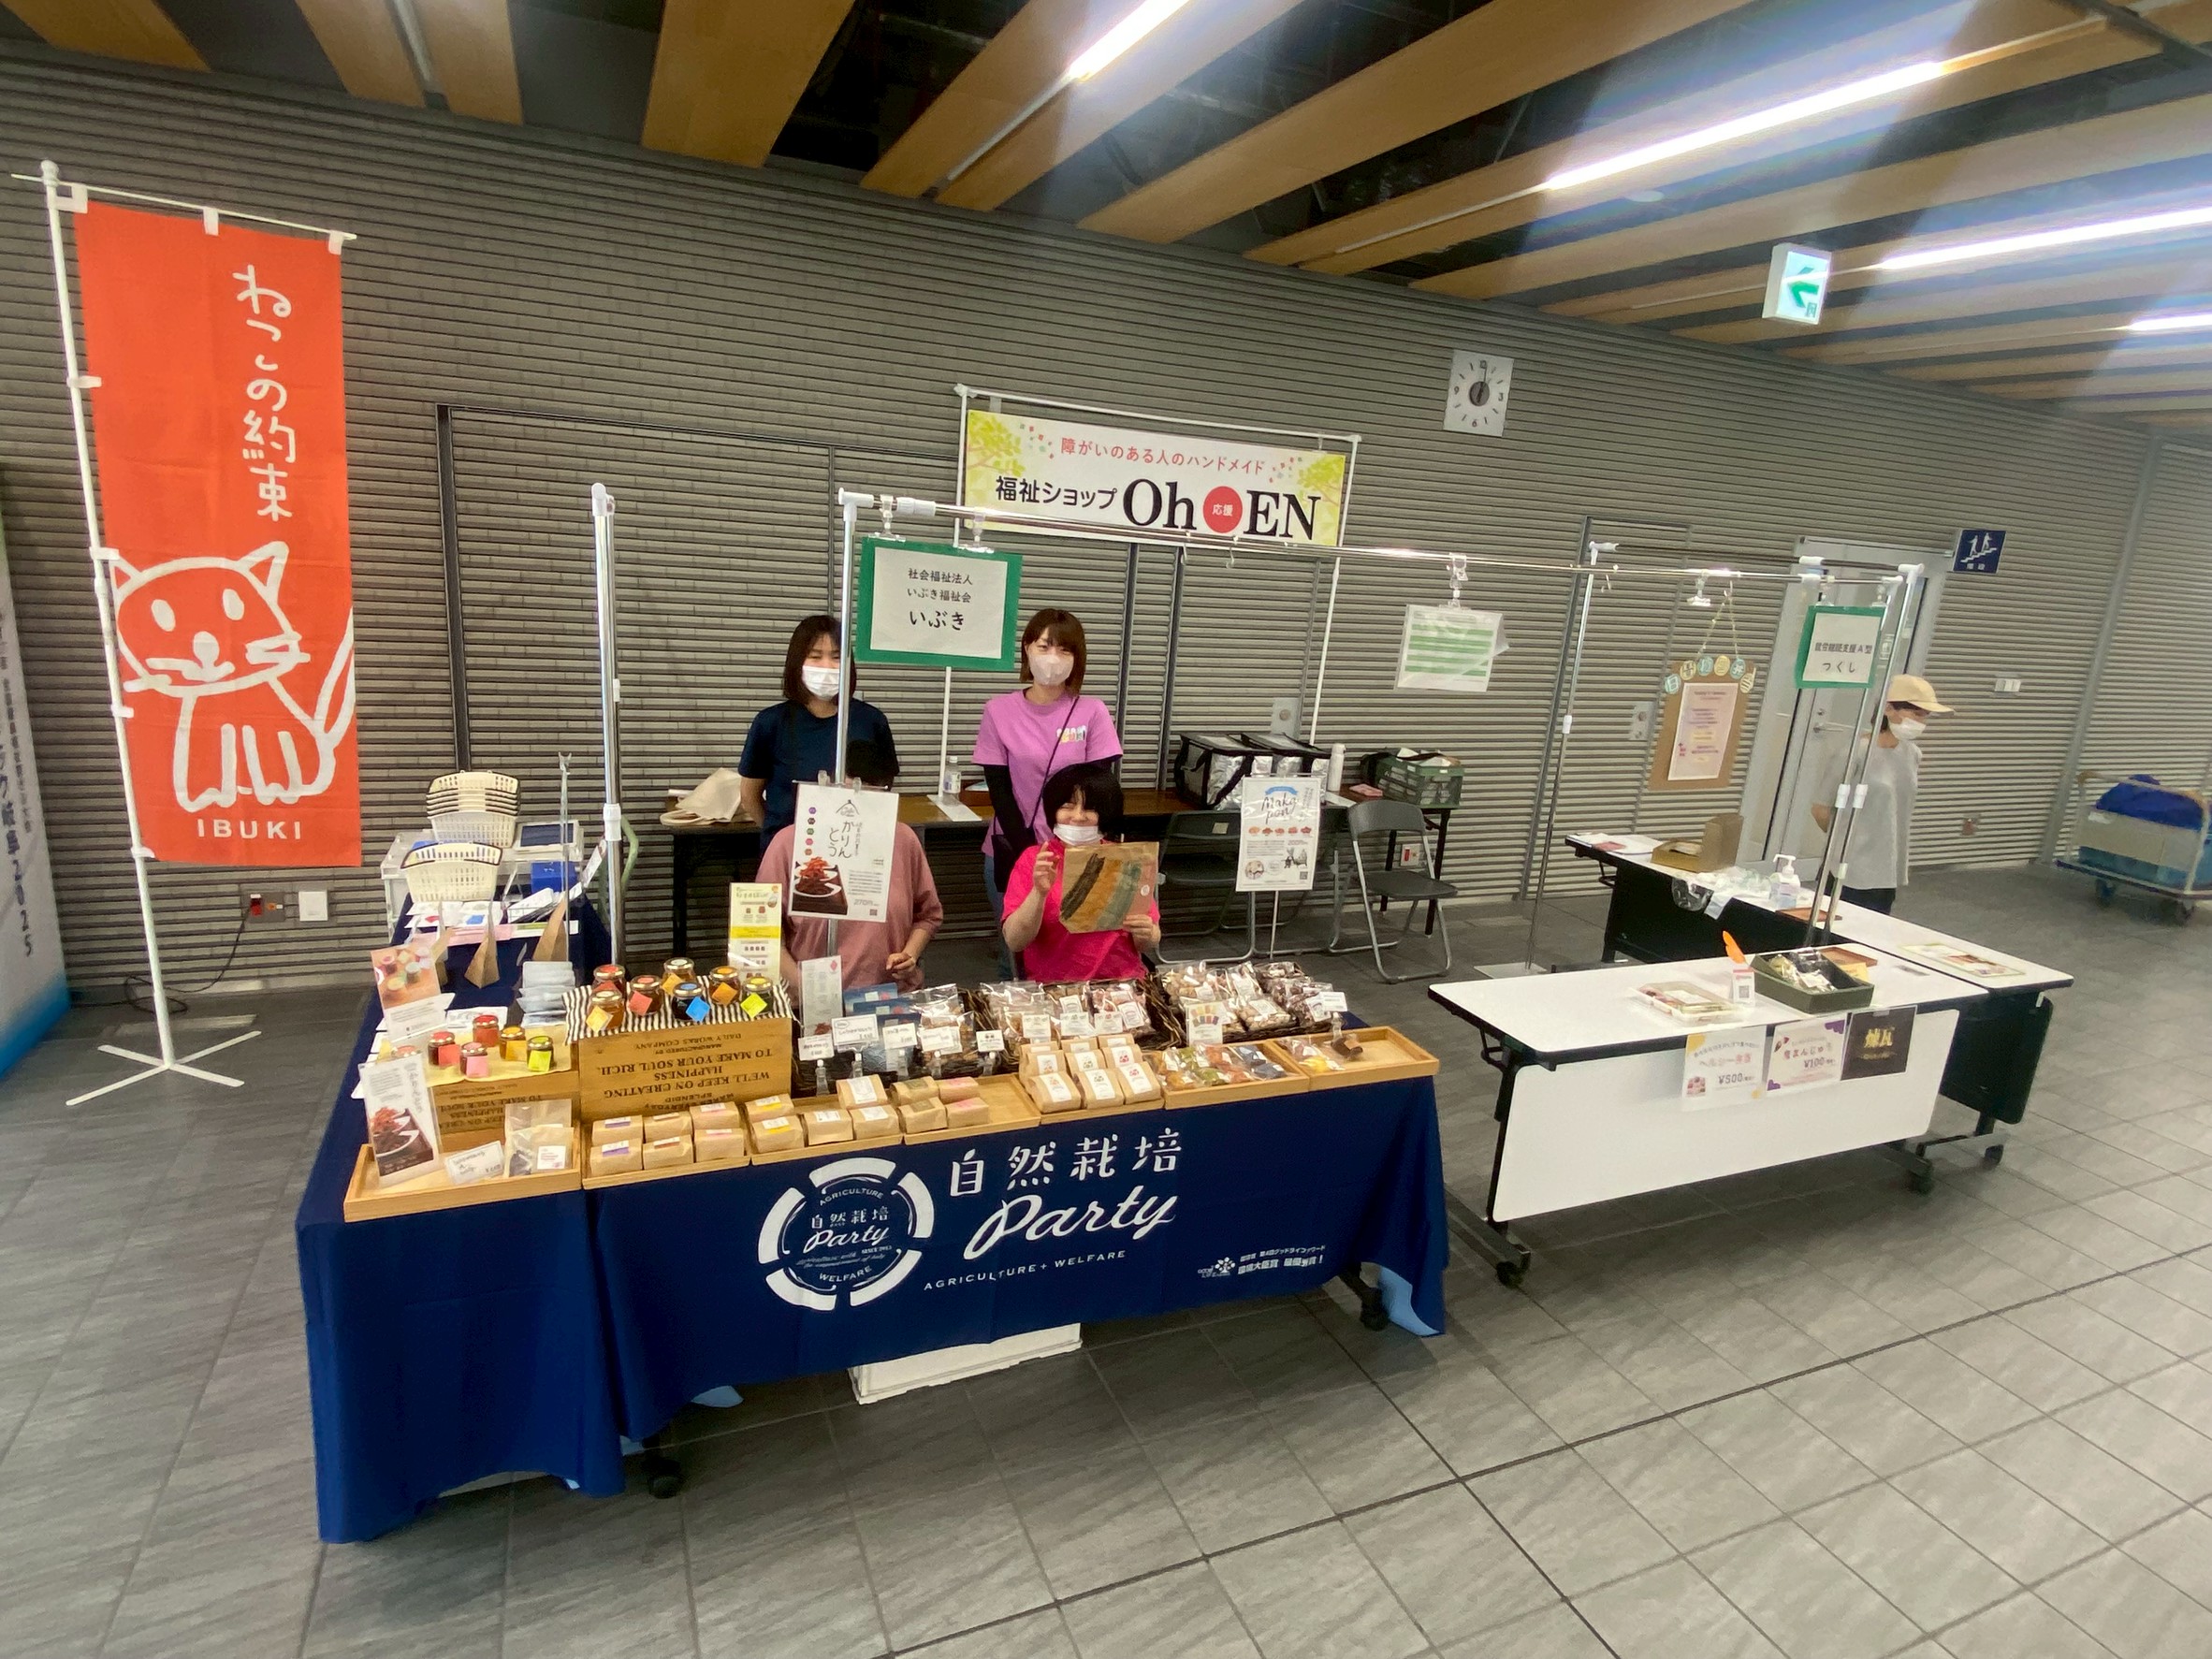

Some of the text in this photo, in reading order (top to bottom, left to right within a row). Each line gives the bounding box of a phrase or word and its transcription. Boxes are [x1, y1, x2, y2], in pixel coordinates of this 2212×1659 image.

[232, 264, 296, 522] ねこの約束
[1060, 436, 1265, 475] 障がいのある人のハンドメイド
[995, 474, 1118, 510] 福祉ショップ
[1123, 478, 1198, 531] Oh
[1243, 489, 1321, 541] EN
[908, 567, 973, 586] 社会福祉法人
[907, 588, 972, 604] いぶき福祉会
[910, 610, 965, 631] いぶき
[1822, 661, 1856, 674] つくし
[196, 817, 303, 841] IBUKI
[677, 1054, 713, 1066] YOUR
[717, 1051, 752, 1061] MAKE
[755, 1048, 772, 1058] TO
[640, 1059, 673, 1070] SOUL
[654, 1066, 722, 1081] HAPPINESS
[604, 1083, 671, 1099] CREATING
[674, 1081, 693, 1090] ON
[698, 1076, 729, 1088] KEEP
[950, 1127, 1182, 1198] 自然栽培
[819, 1187, 884, 1207] AGRICULTURE
[811, 1205, 889, 1229] 自然栽培
[963, 1185, 1179, 1260] Party
[803, 1225, 890, 1254] Party
[1054, 1249, 1127, 1269] WELFARE
[819, 1265, 873, 1283] WELFARE
